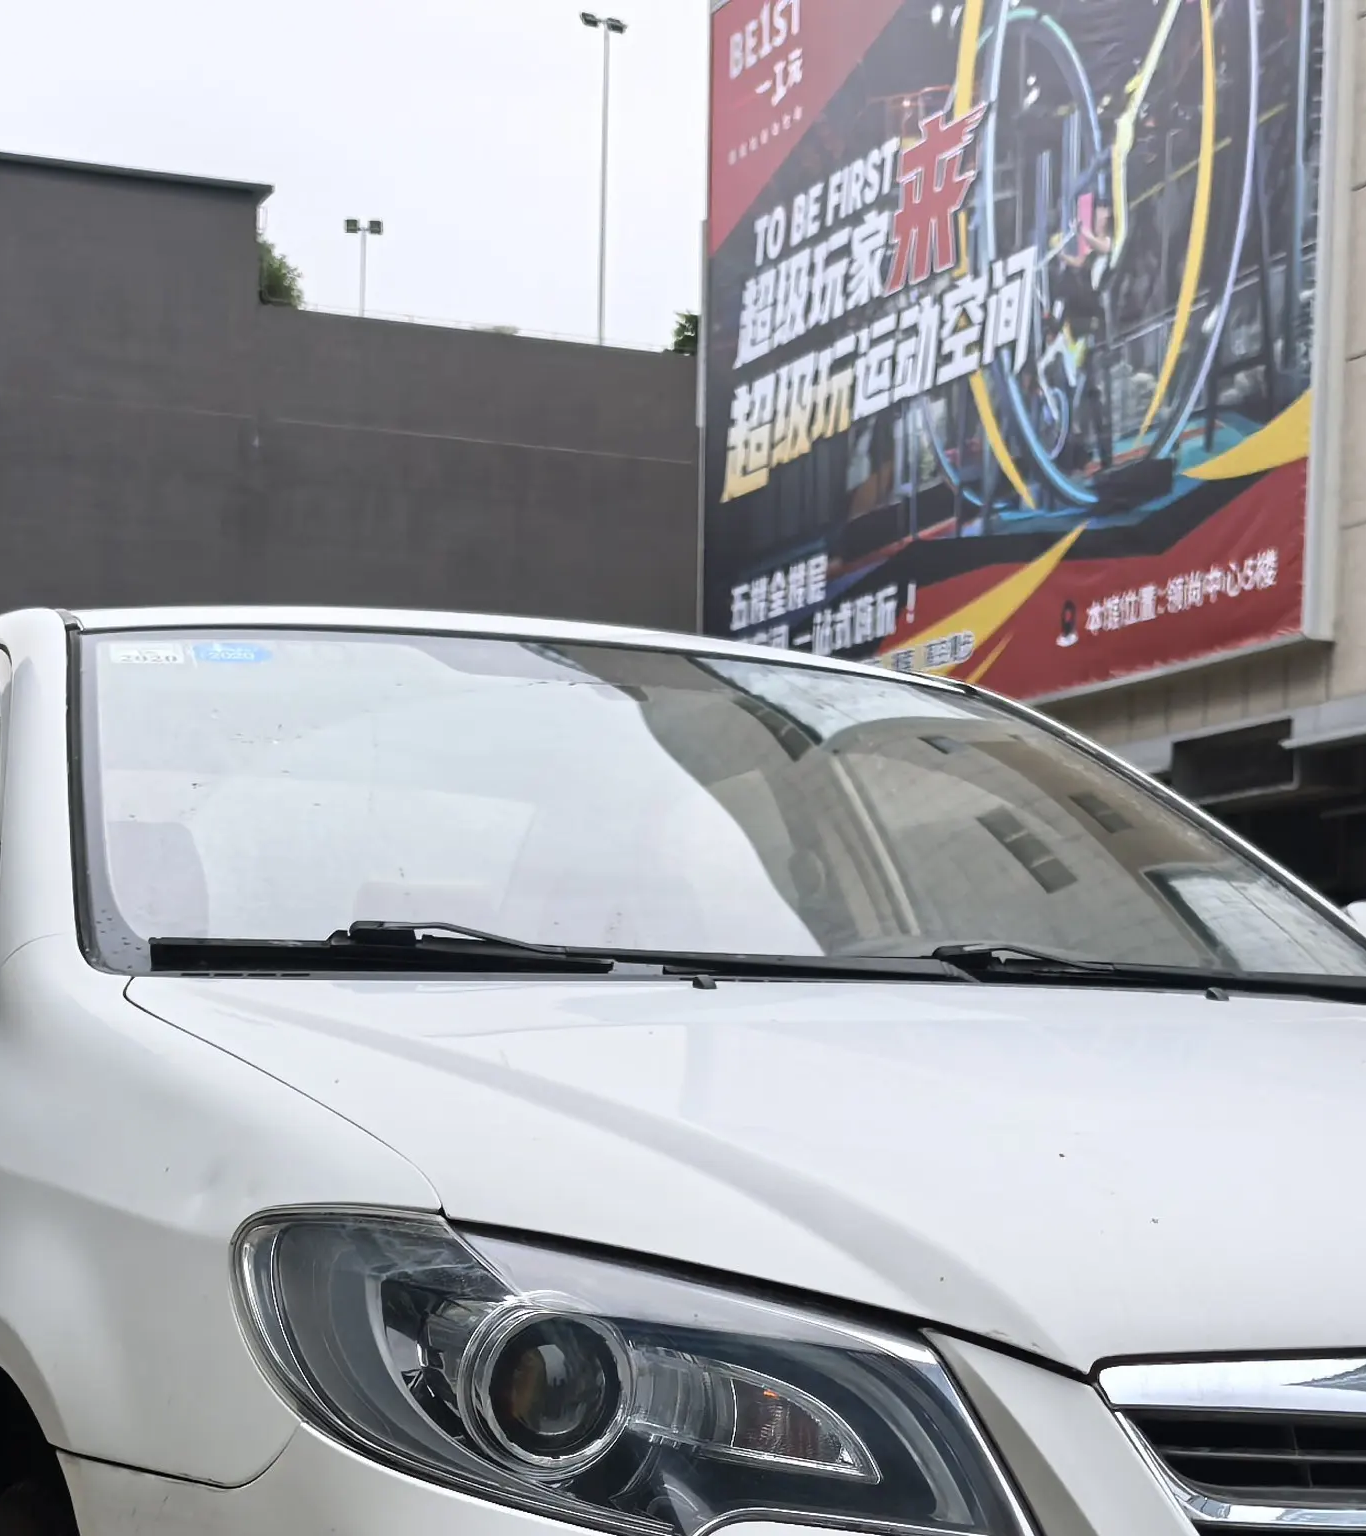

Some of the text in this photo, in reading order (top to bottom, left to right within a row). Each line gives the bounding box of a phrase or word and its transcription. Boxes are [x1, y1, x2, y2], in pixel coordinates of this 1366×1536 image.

[753, 205, 786, 267] TO
[790, 181, 825, 248] BE
[825, 135, 901, 228] FIRST
[719, 244, 1037, 504] 超级玩运动空间
